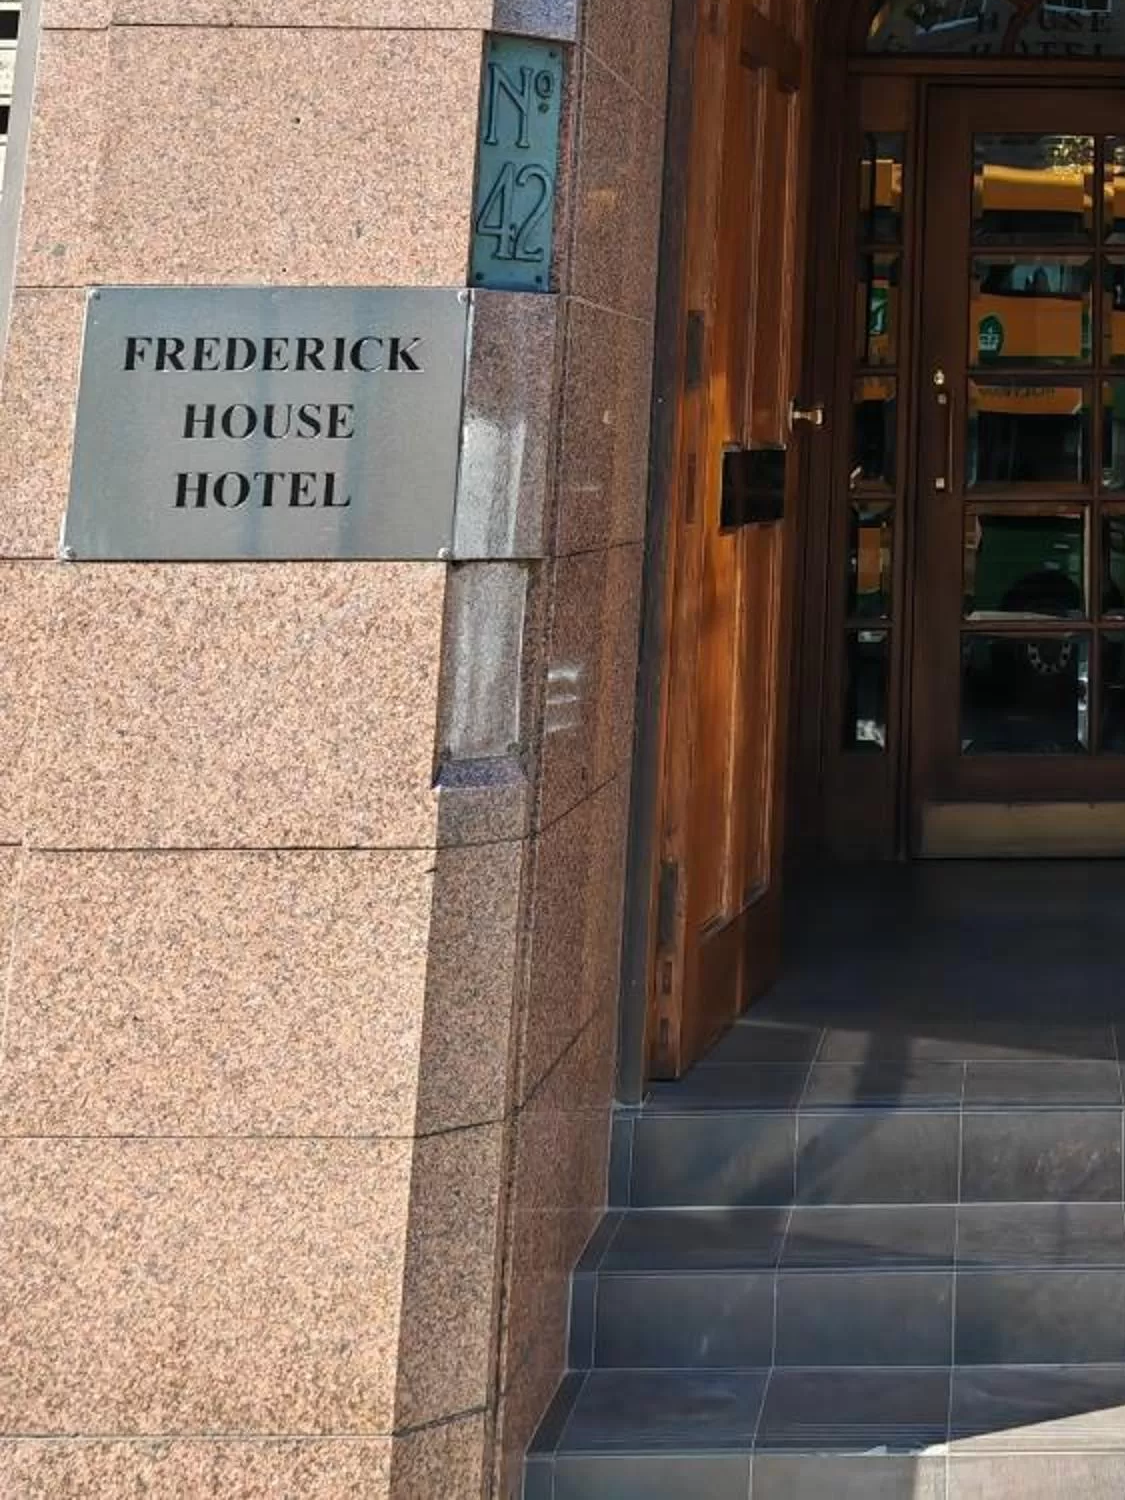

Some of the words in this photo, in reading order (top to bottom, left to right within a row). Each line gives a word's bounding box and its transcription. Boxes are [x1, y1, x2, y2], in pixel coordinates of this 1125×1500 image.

[475, 161, 551, 262] 42
[123, 336, 424, 373] FREDERICK
[181, 403, 355, 440] HOUSE
[171, 471, 352, 509] HOTEL
